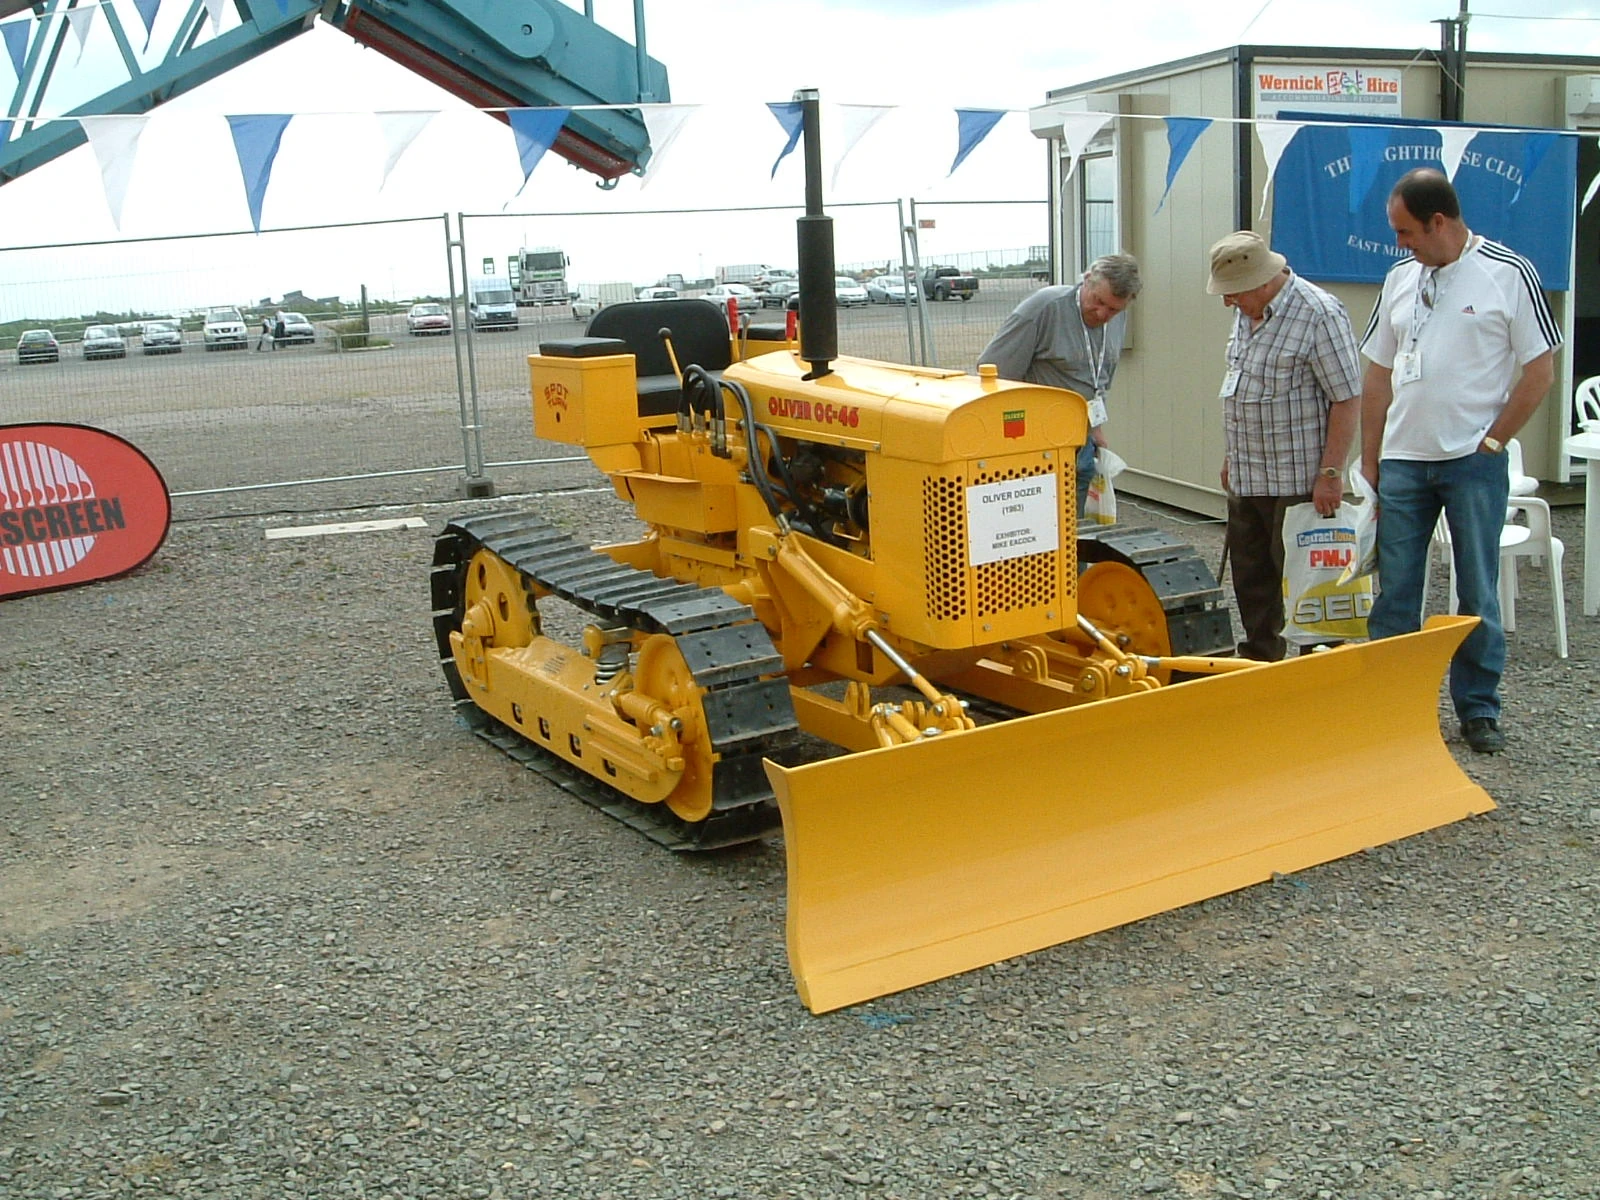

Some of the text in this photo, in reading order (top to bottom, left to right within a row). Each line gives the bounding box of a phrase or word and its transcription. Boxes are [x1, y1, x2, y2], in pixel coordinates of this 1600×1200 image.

[1259, 75, 1398, 93] Wernick Hire
[1324, 154, 1351, 179] TH
[1347, 233, 1414, 259] EAST MID
[544, 383, 569, 400] SPOT
[769, 396, 859, 428] OLIVER OC-46
[982, 486, 1042, 504] OLIVER DOZER
[0, 497, 126, 547] SCREEN
[1310, 549, 1352, 568] PMJ
